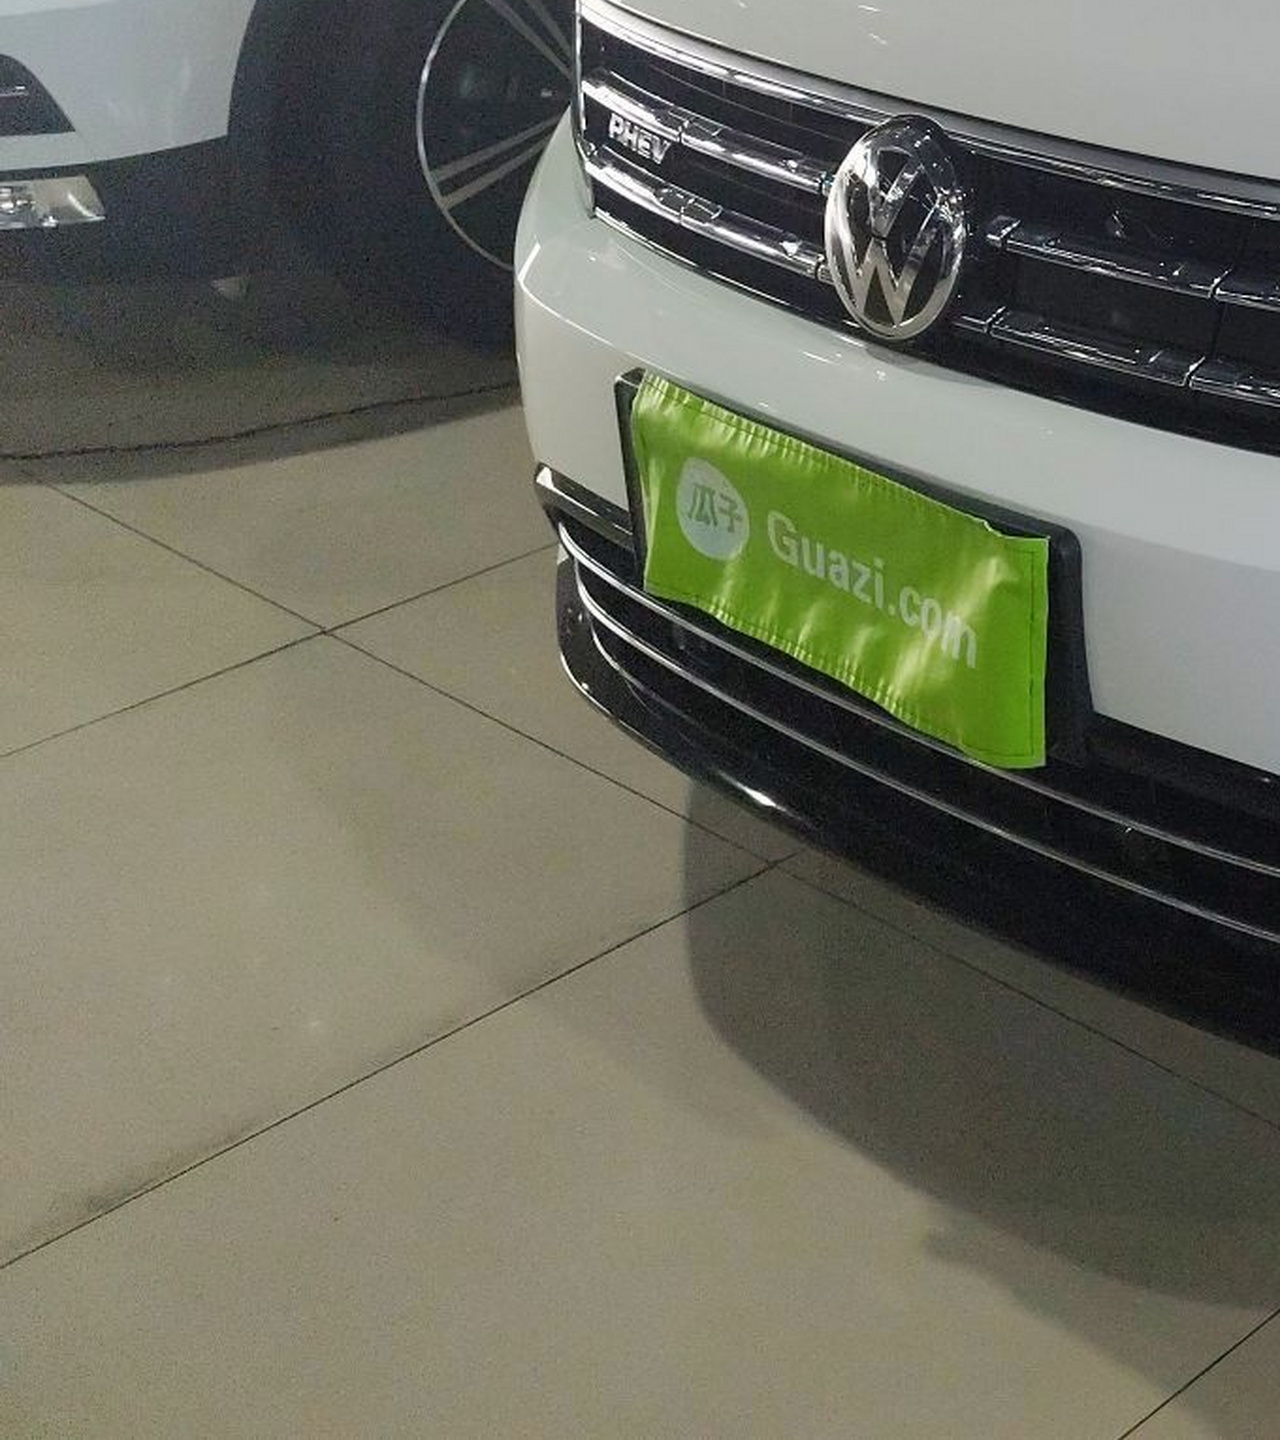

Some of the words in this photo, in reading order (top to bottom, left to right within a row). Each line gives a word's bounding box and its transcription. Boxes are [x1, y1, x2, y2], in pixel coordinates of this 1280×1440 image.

[608, 112, 672, 165] PHEV
[687, 482, 744, 535] 瓜子
[766, 510, 978, 670] Guazi.com
